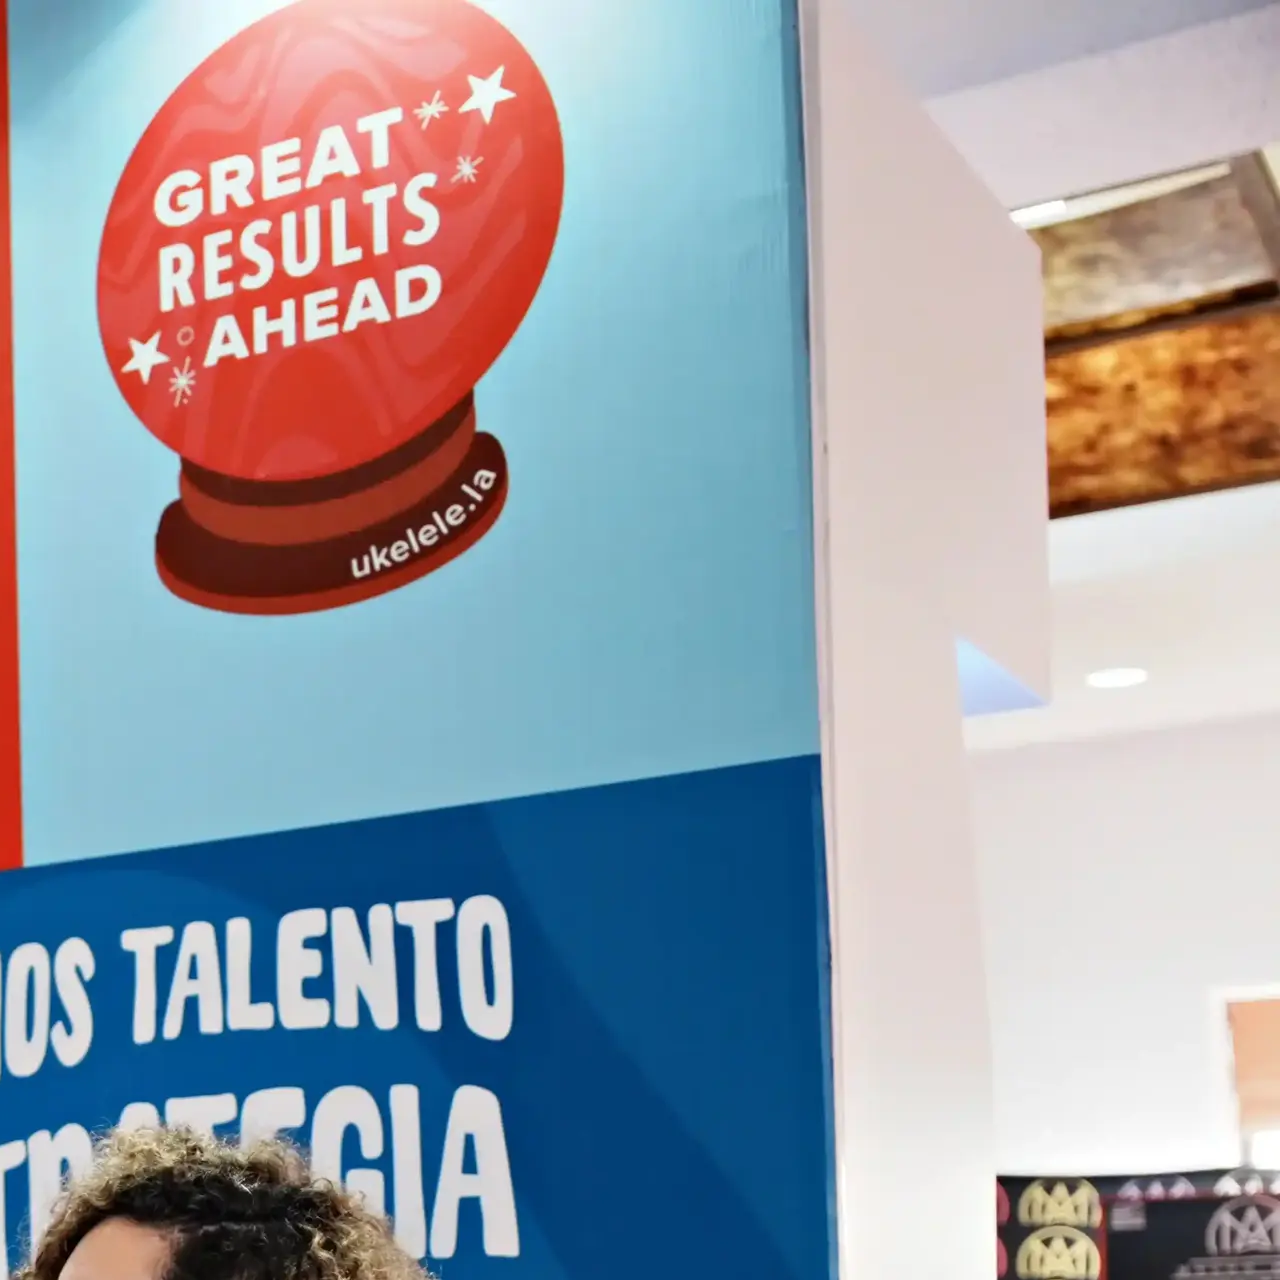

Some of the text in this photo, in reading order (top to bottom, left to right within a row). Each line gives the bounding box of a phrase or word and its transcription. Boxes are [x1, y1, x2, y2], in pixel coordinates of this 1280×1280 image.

[153, 107, 403, 227] GREAT
[157, 173, 441, 313] RESULTS
[203, 264, 443, 368] AHEAD
[351, 466, 497, 578] ukelele.la
[120, 895, 514, 1047] TALENTO
